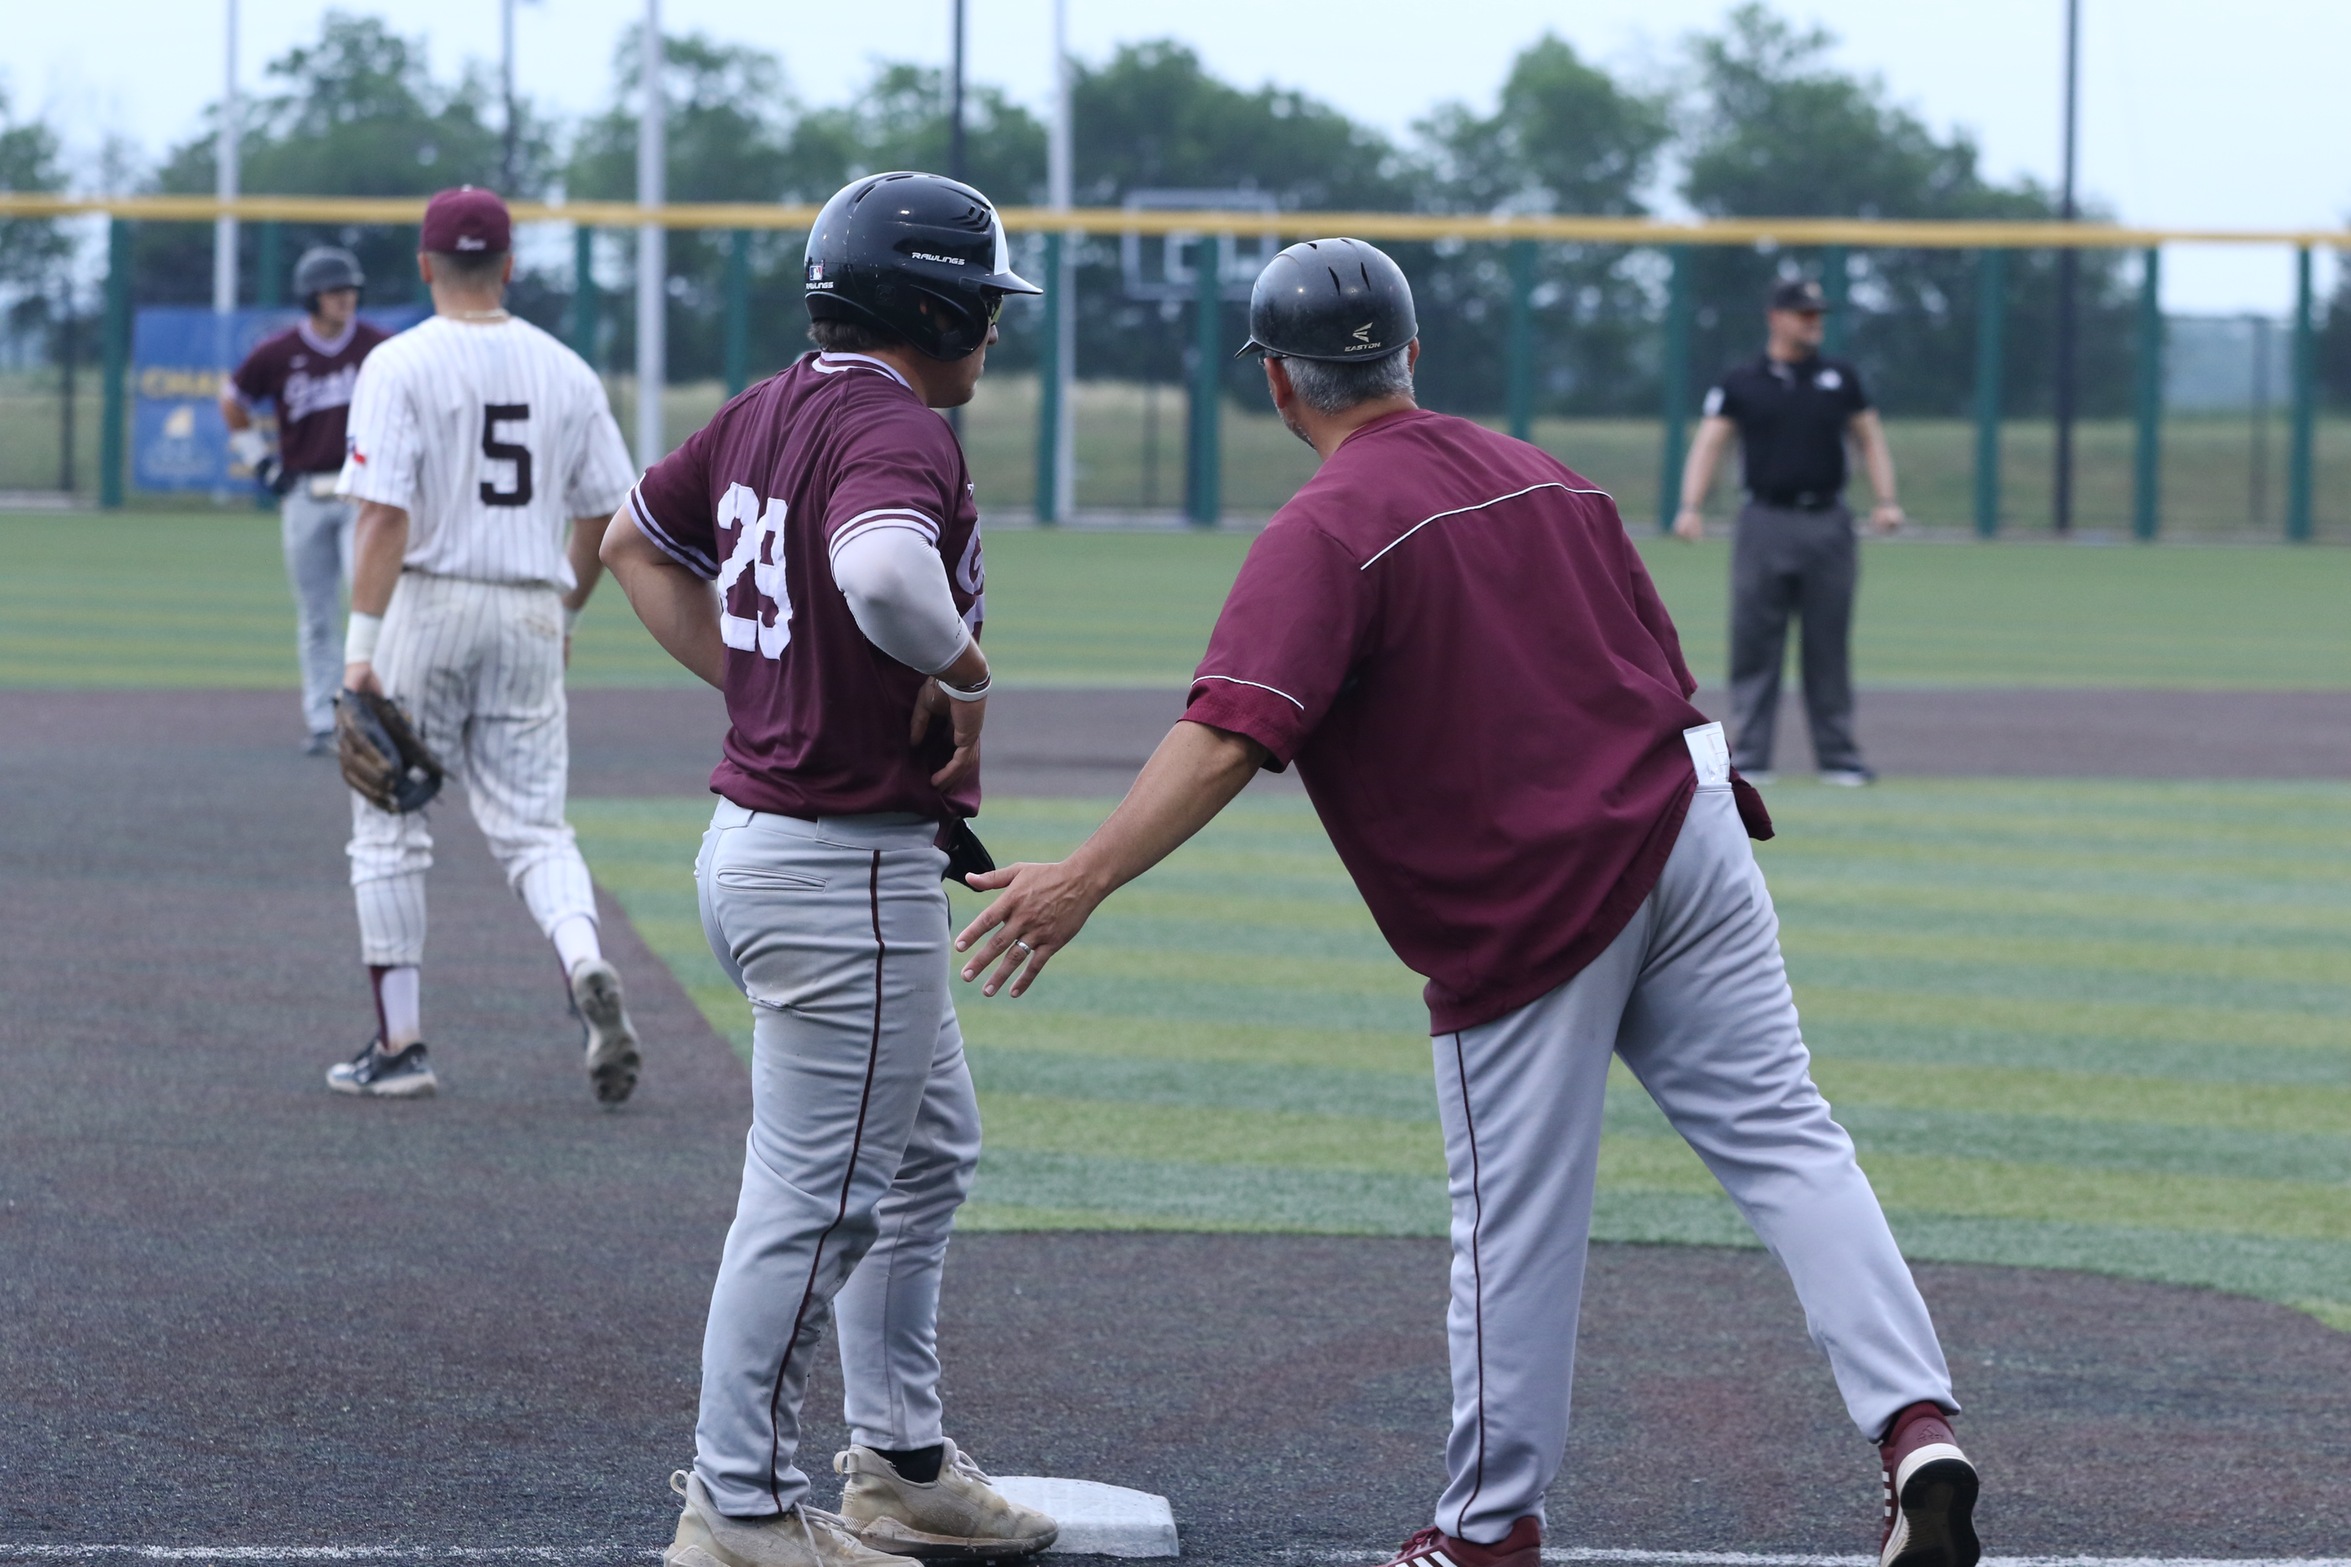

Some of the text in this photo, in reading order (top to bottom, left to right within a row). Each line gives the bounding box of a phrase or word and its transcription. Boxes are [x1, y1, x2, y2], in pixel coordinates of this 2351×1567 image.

[911, 251, 966, 266] RAWLINGS
[1344, 341, 1382, 352] EASTON
[479, 403, 533, 507] 5
[717, 481, 794, 661] 29
